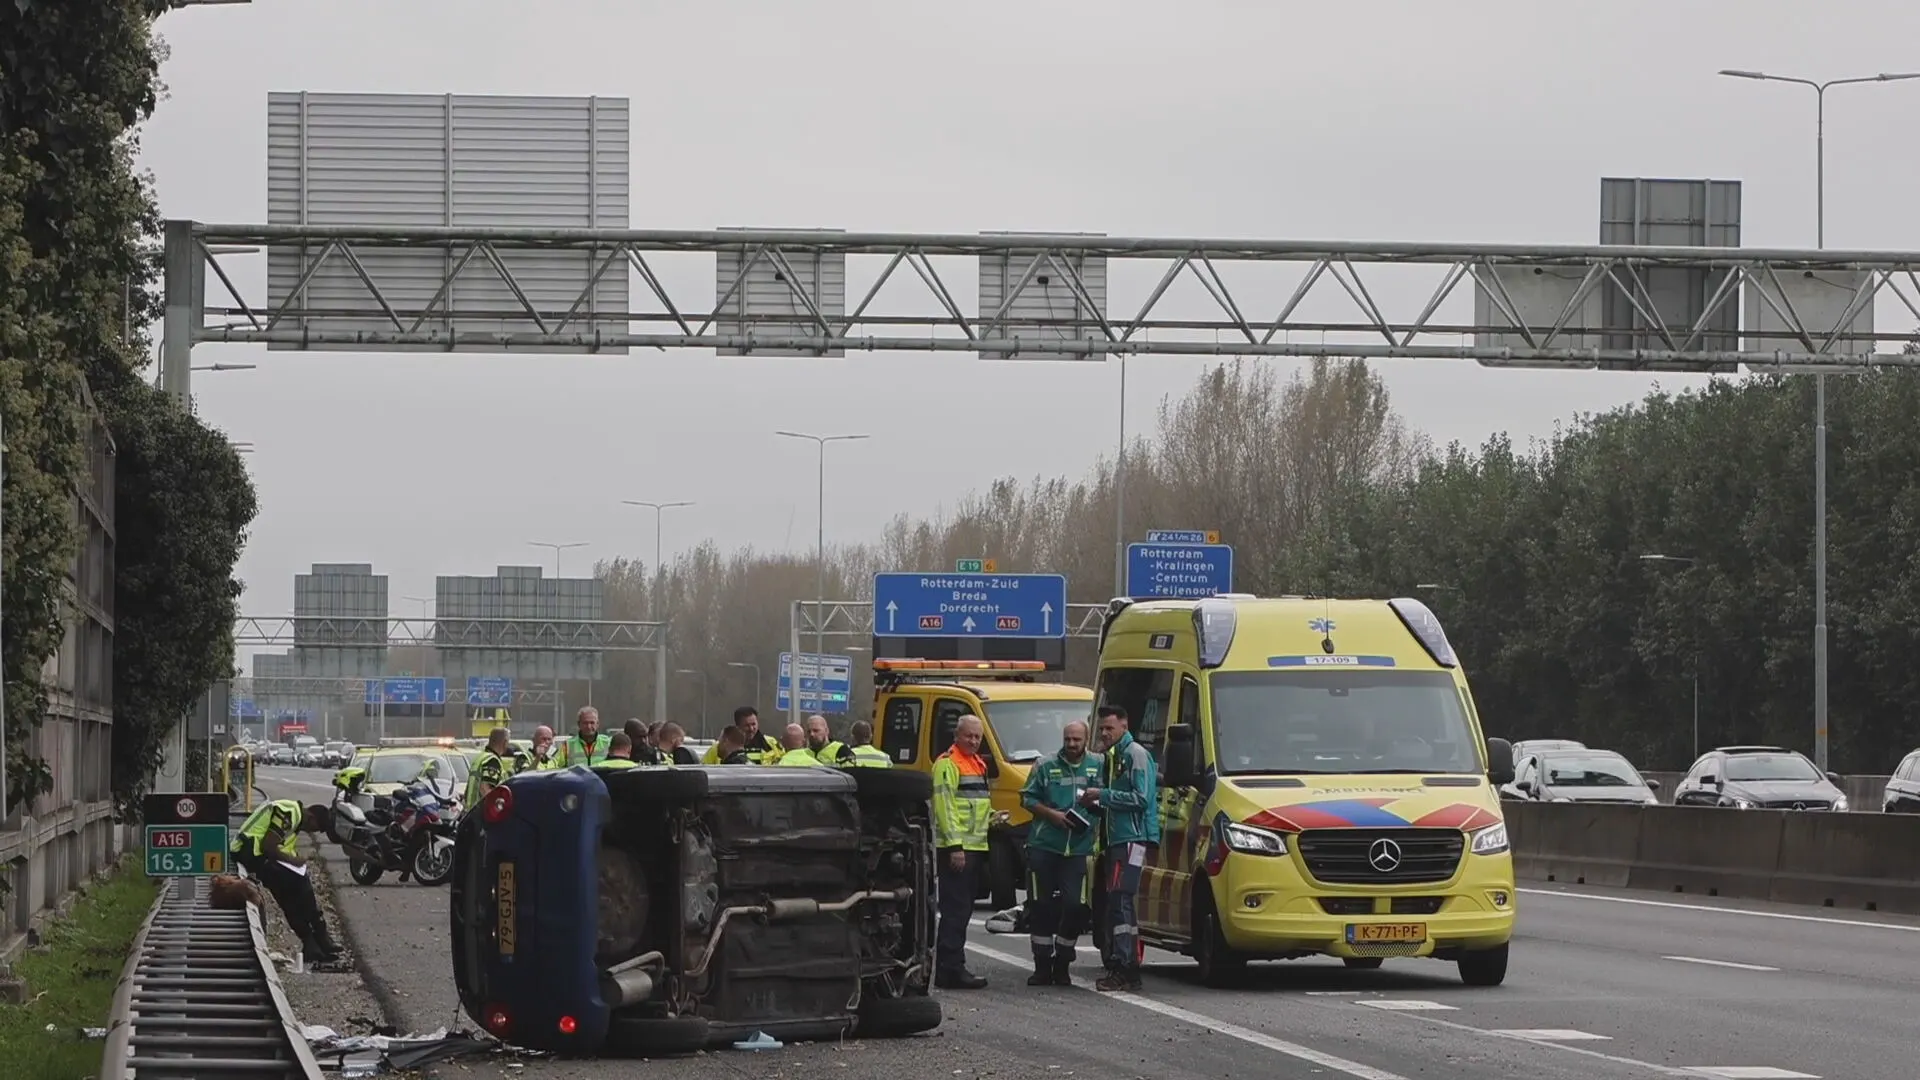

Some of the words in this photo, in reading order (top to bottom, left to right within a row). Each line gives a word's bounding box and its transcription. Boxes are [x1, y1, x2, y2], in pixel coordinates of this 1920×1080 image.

[1140, 548, 1204, 559] Rotterdam
[920, 578, 1019, 589] Rotterdam-Zuid
[952, 591, 987, 601] Breda
[940, 603, 1000, 613] Dordrecht
[921, 617, 940, 627] A16
[999, 618, 1018, 628] A16
[178, 802, 196, 813] 100
[158, 833, 185, 846] A16
[151, 852, 193, 872] 16,3
[209, 856, 217, 870] f
[500, 869, 513, 946] 79-GJV-5
[1362, 925, 1419, 939] K-771-PF
